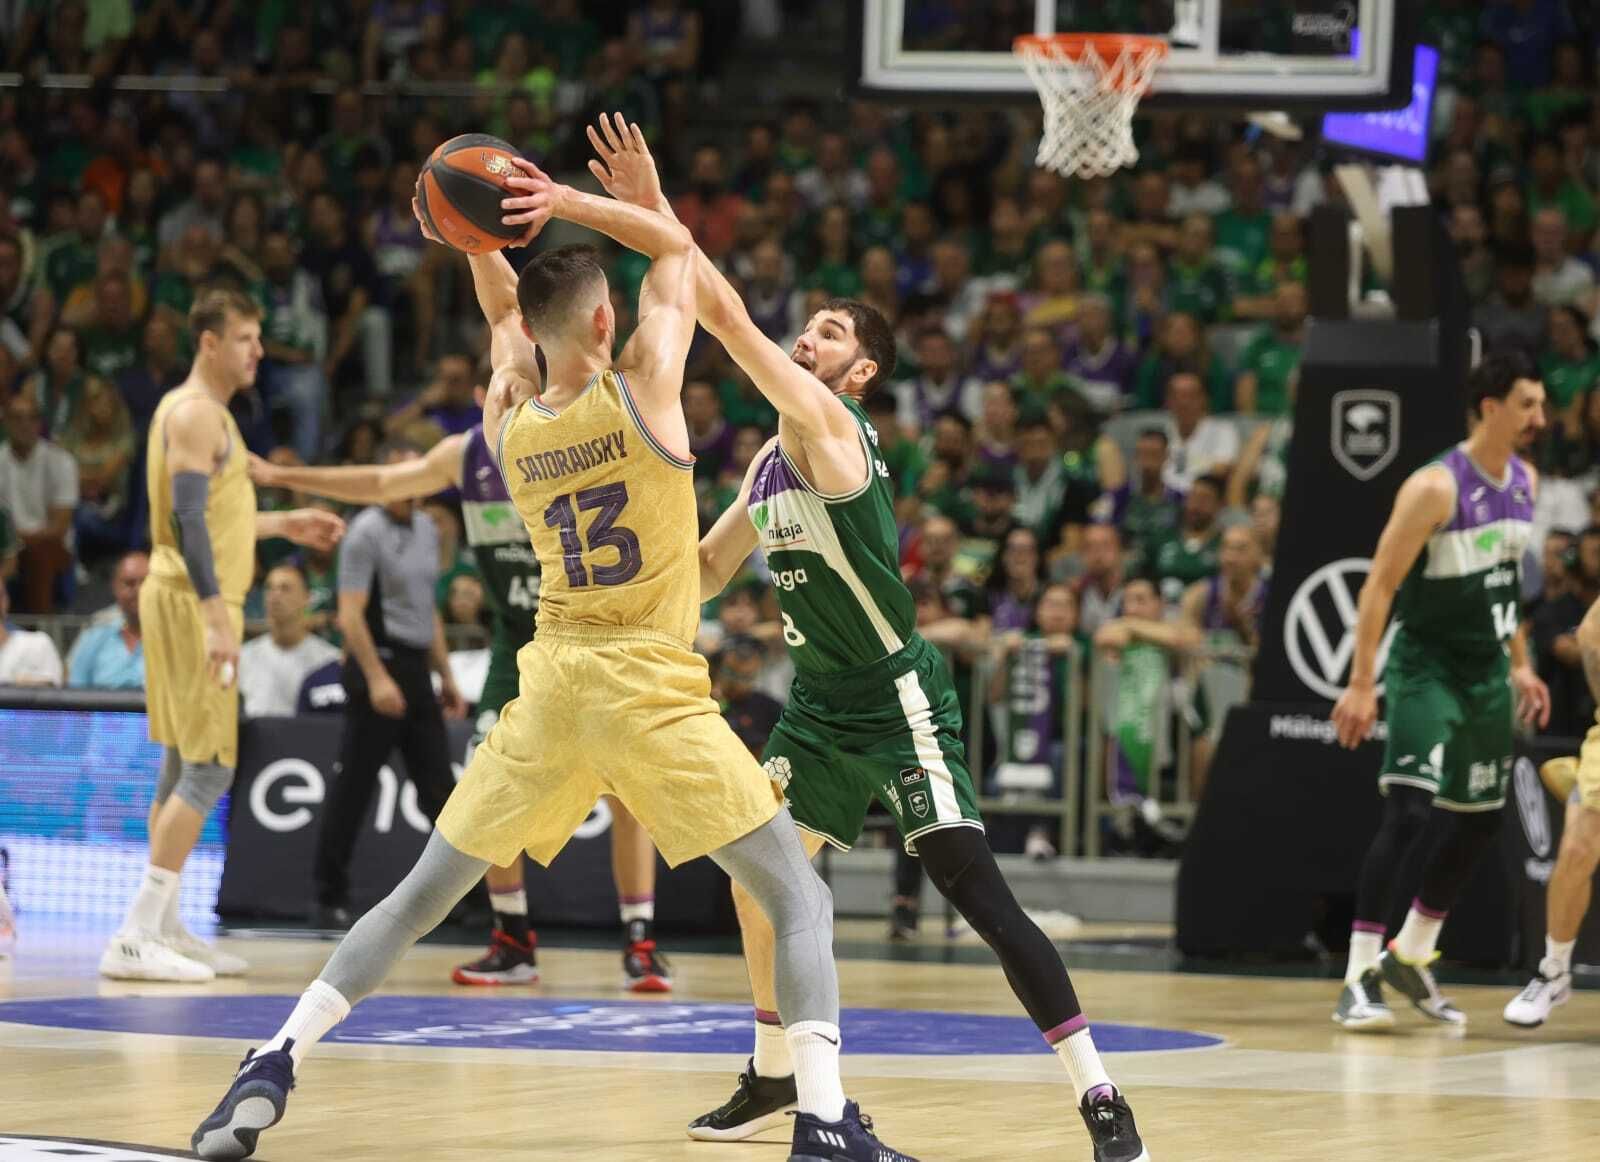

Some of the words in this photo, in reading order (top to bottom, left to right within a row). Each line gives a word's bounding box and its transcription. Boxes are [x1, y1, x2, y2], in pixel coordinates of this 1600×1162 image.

[516, 430, 628, 483] SATORANSKY
[544, 480, 643, 588] 13
[1491, 600, 1518, 640] 14
[904, 772, 920, 783] acb
